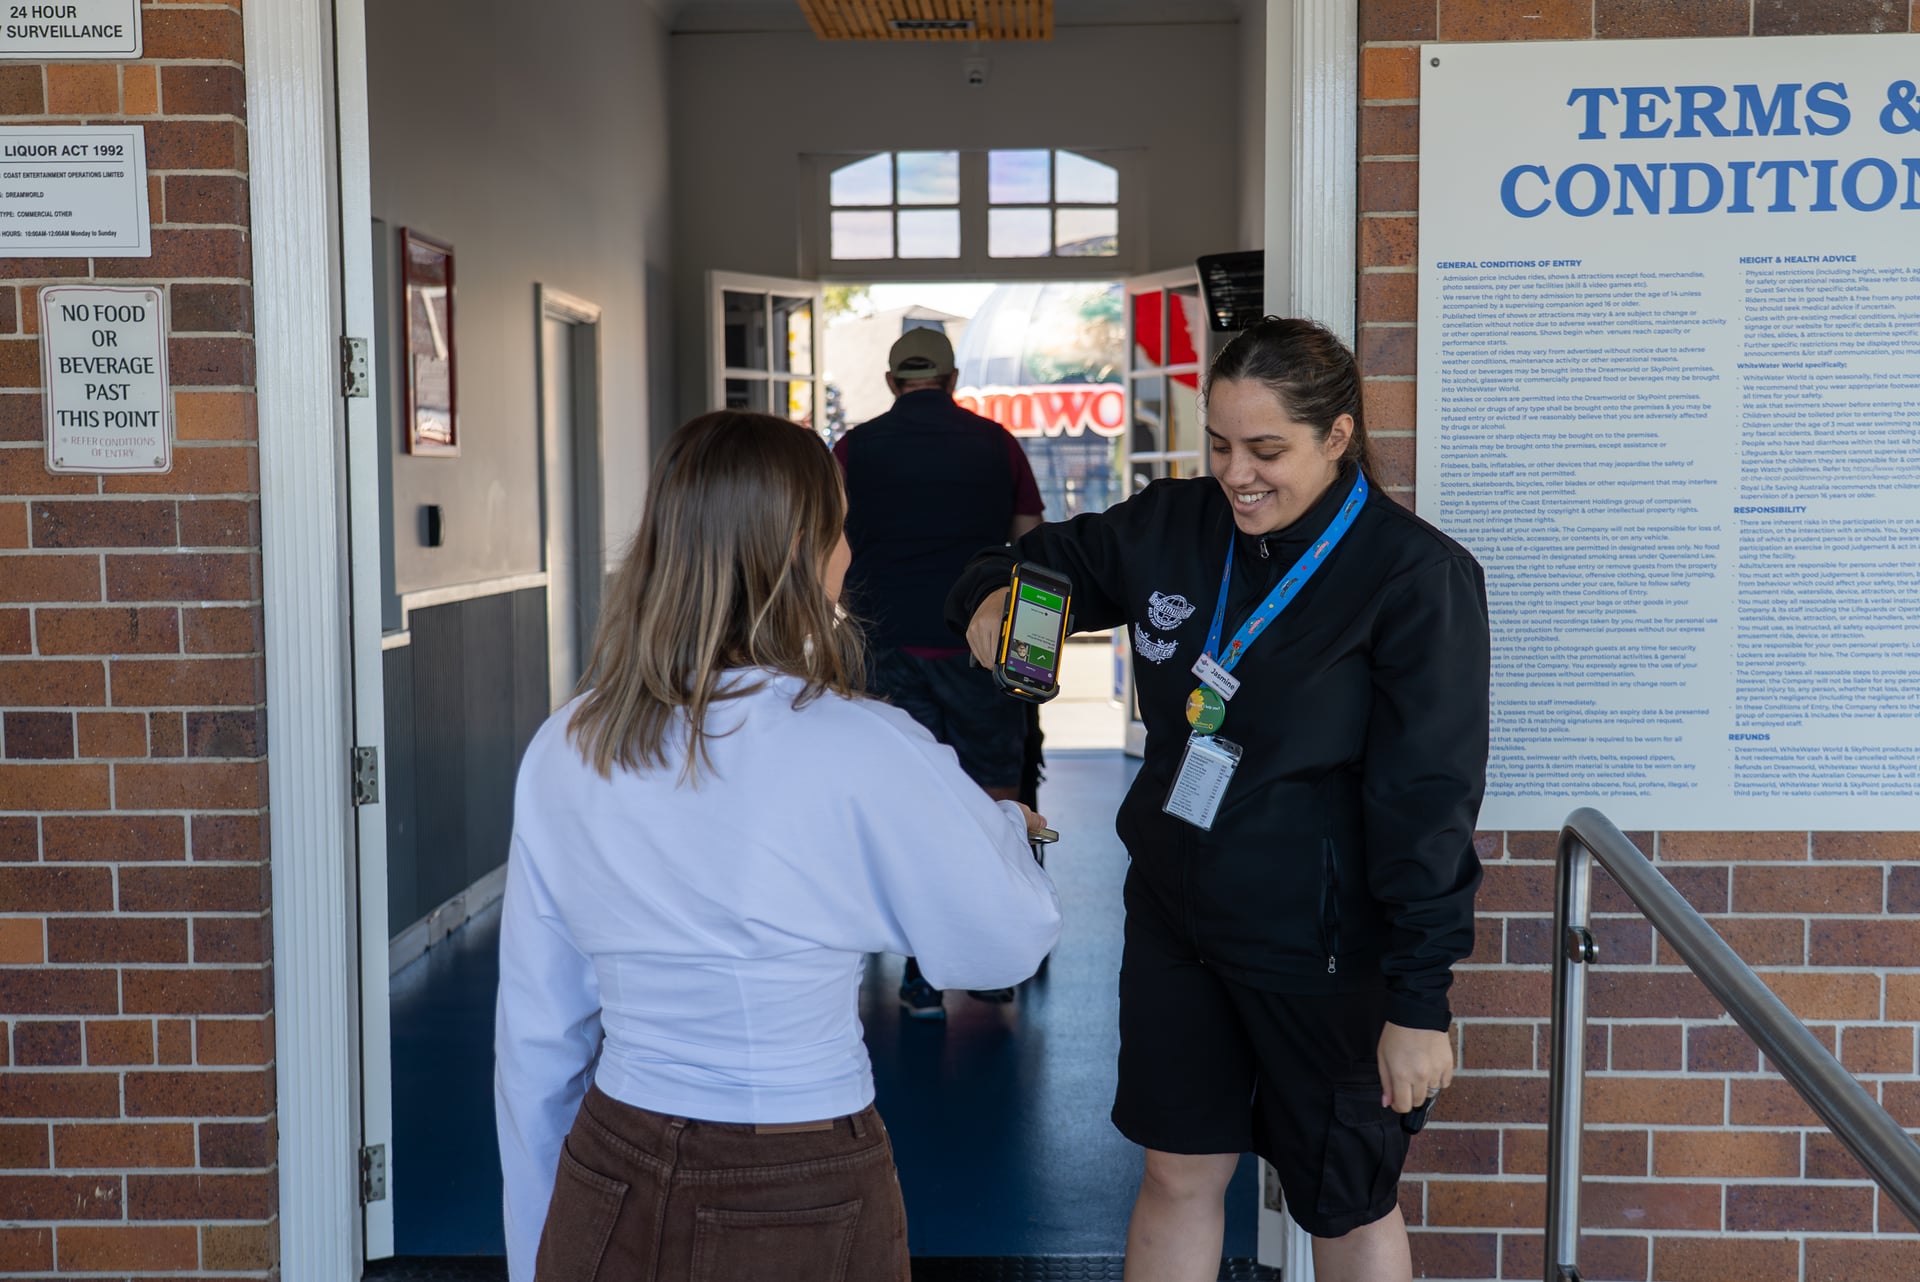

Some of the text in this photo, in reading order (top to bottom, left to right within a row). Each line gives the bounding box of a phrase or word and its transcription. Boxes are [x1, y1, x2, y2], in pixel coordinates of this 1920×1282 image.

[10, 6, 76, 18] 24 HOUR
[7, 25, 122, 38] SURVEILLANCE
[1566, 79, 1920, 140] TERMS &
[5, 145, 123, 157] LIQUOR ACT 1992
[1479, 274, 1497, 282] price
[62, 304, 145, 322] NO FOOD
[92, 330, 117, 347] OR
[59, 357, 154, 374] BEVERAGE
[86, 384, 130, 401] PAST
[57, 410, 159, 428] THIS POINT
[71, 436, 155, 447] REFER CONDITIONS
[91, 448, 135, 459] OF ENTRY
[1440, 508, 1454, 516] (the
[1455, 507, 1490, 517] Company)
[1546, 508, 1580, 516] copyright
[1486, 517, 1513, 525] infringe
[1739, 553, 1758, 561] using
[1210, 668, 1235, 691] Jasmine
[1534, 718, 1566, 726] matching
